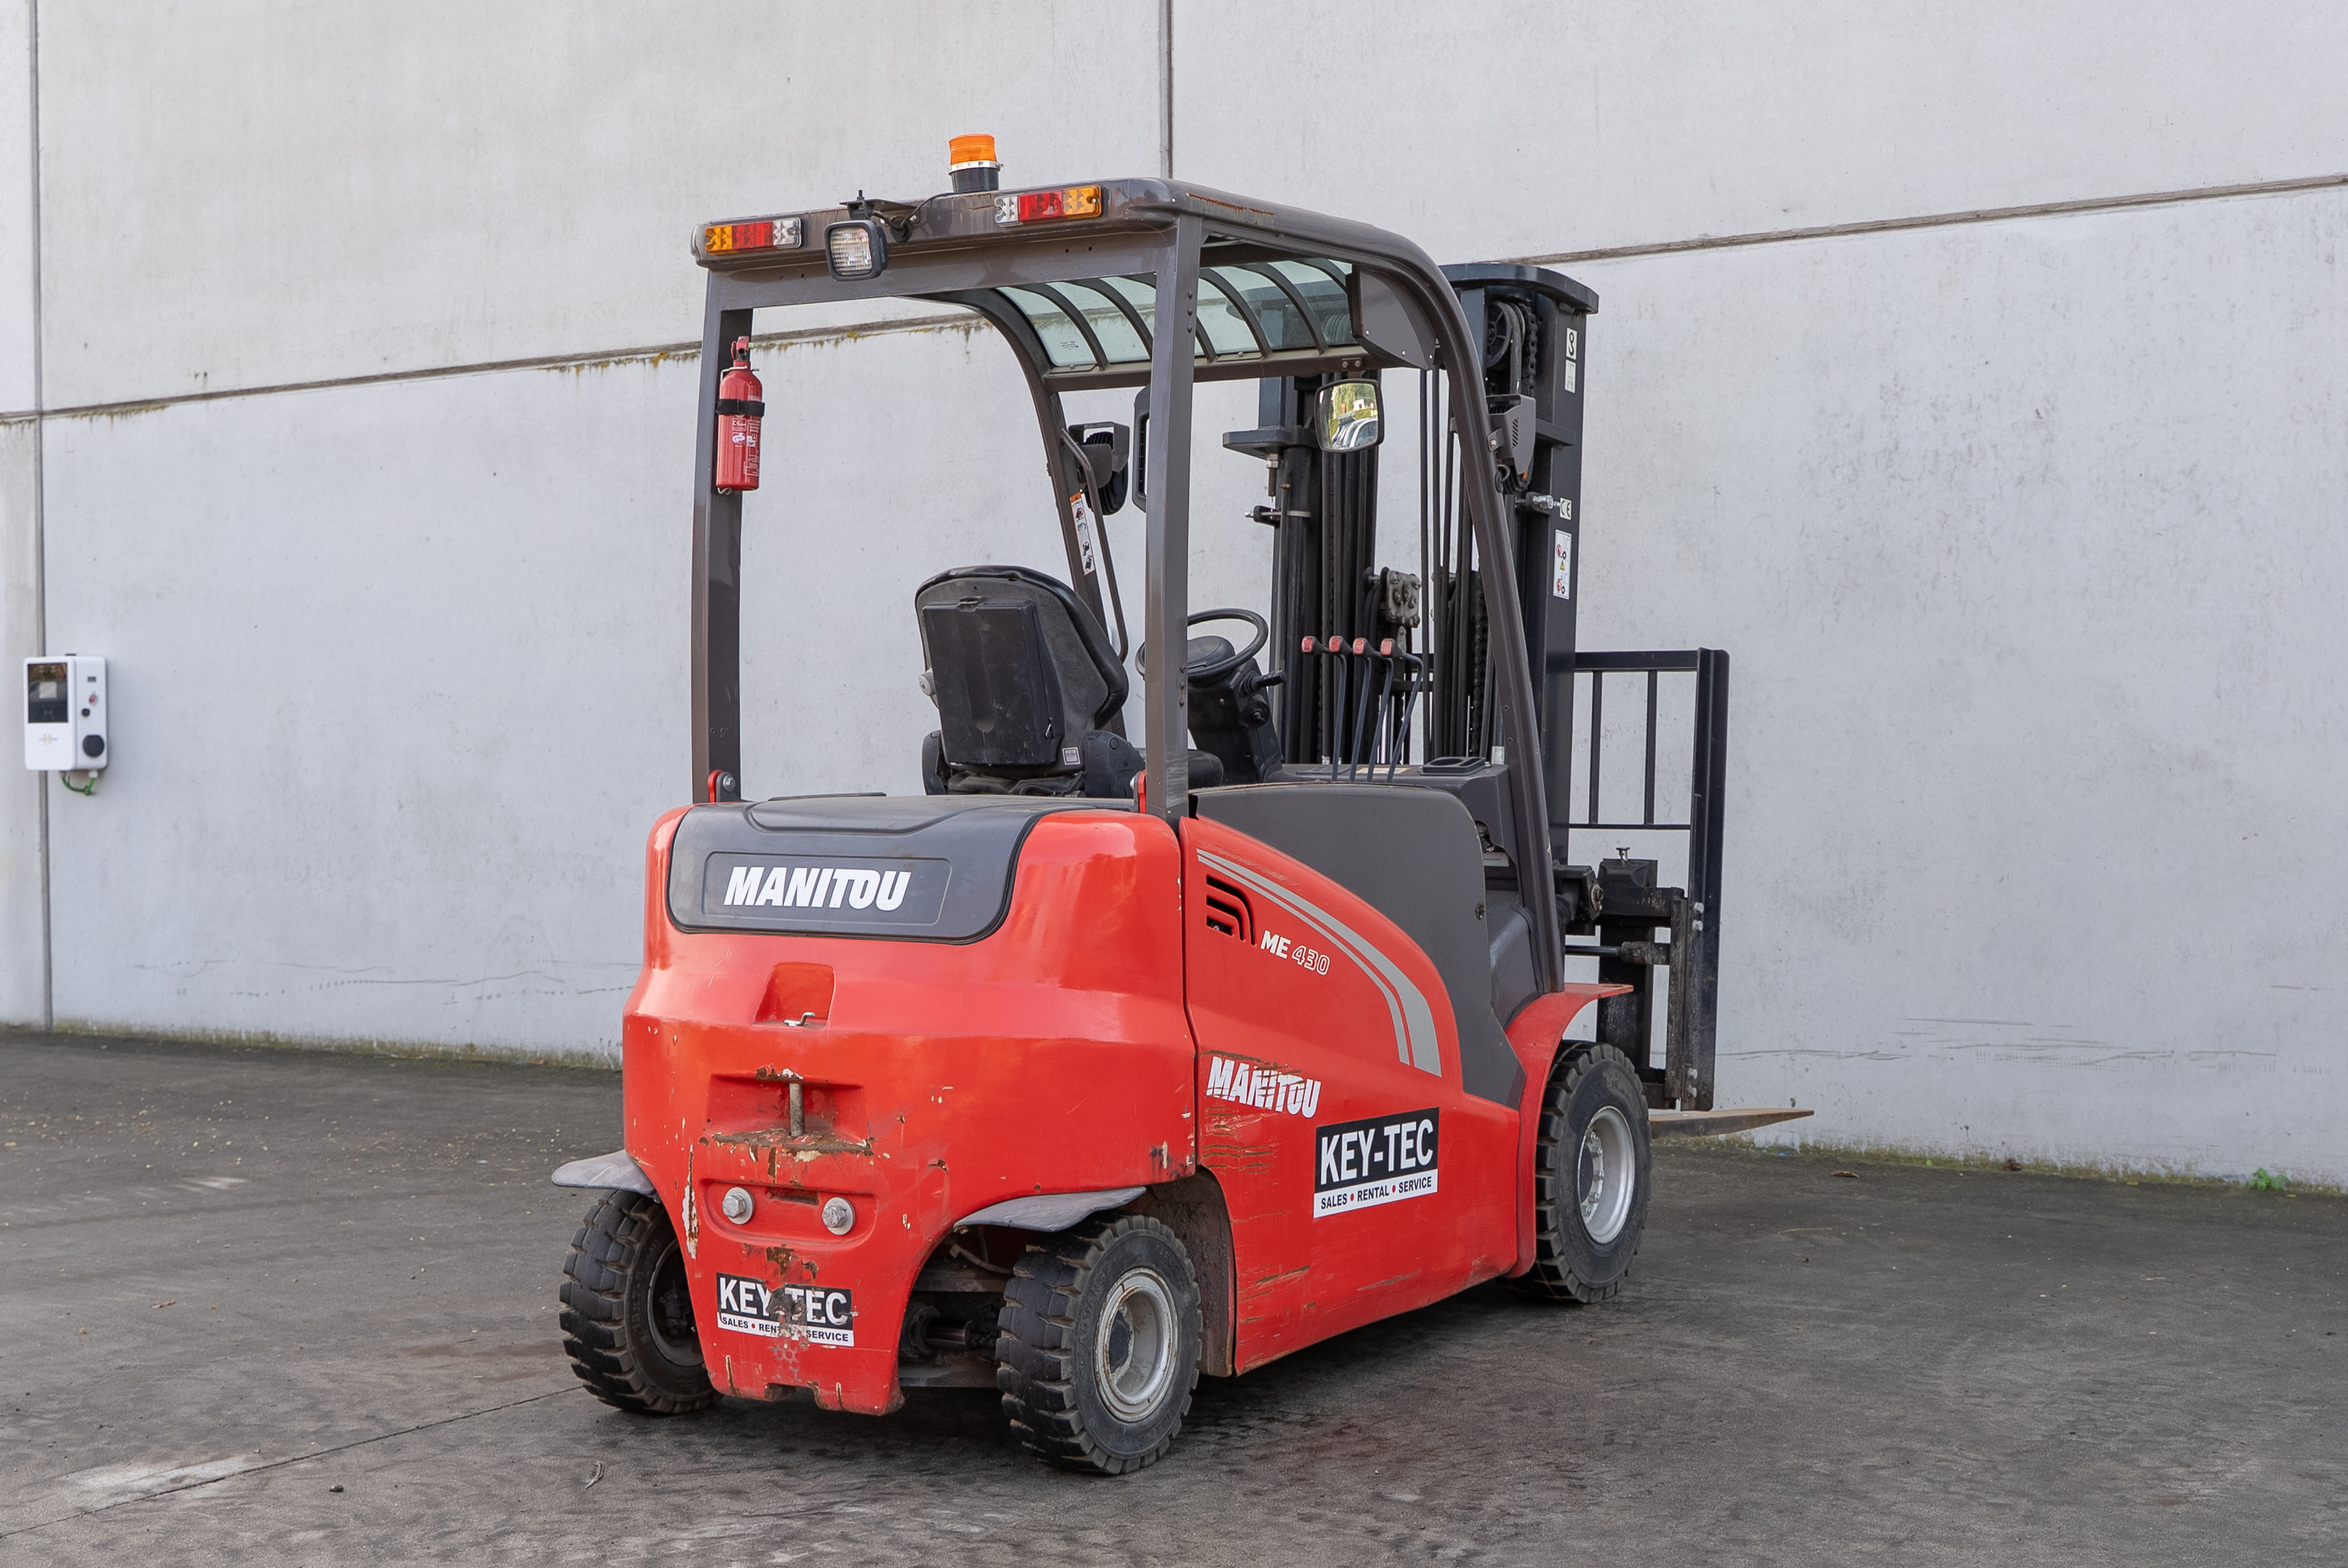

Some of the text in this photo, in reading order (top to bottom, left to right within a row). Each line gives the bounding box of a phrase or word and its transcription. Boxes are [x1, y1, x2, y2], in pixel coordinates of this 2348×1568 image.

[1561, 500, 1570, 517] CE
[723, 866, 912, 912] MANITOU
[1260, 930, 1331, 976] ME 430
[1206, 1056, 1322, 1119] MANITOU
[1320, 1119, 1433, 1185] KEY-TEC
[1320, 1176, 1432, 1209] SALES RENTAL SERVICE
[720, 1277, 849, 1325] KEYTEC
[722, 1317, 749, 1329] SALES
[805, 1329, 849, 1342] SERVICE
